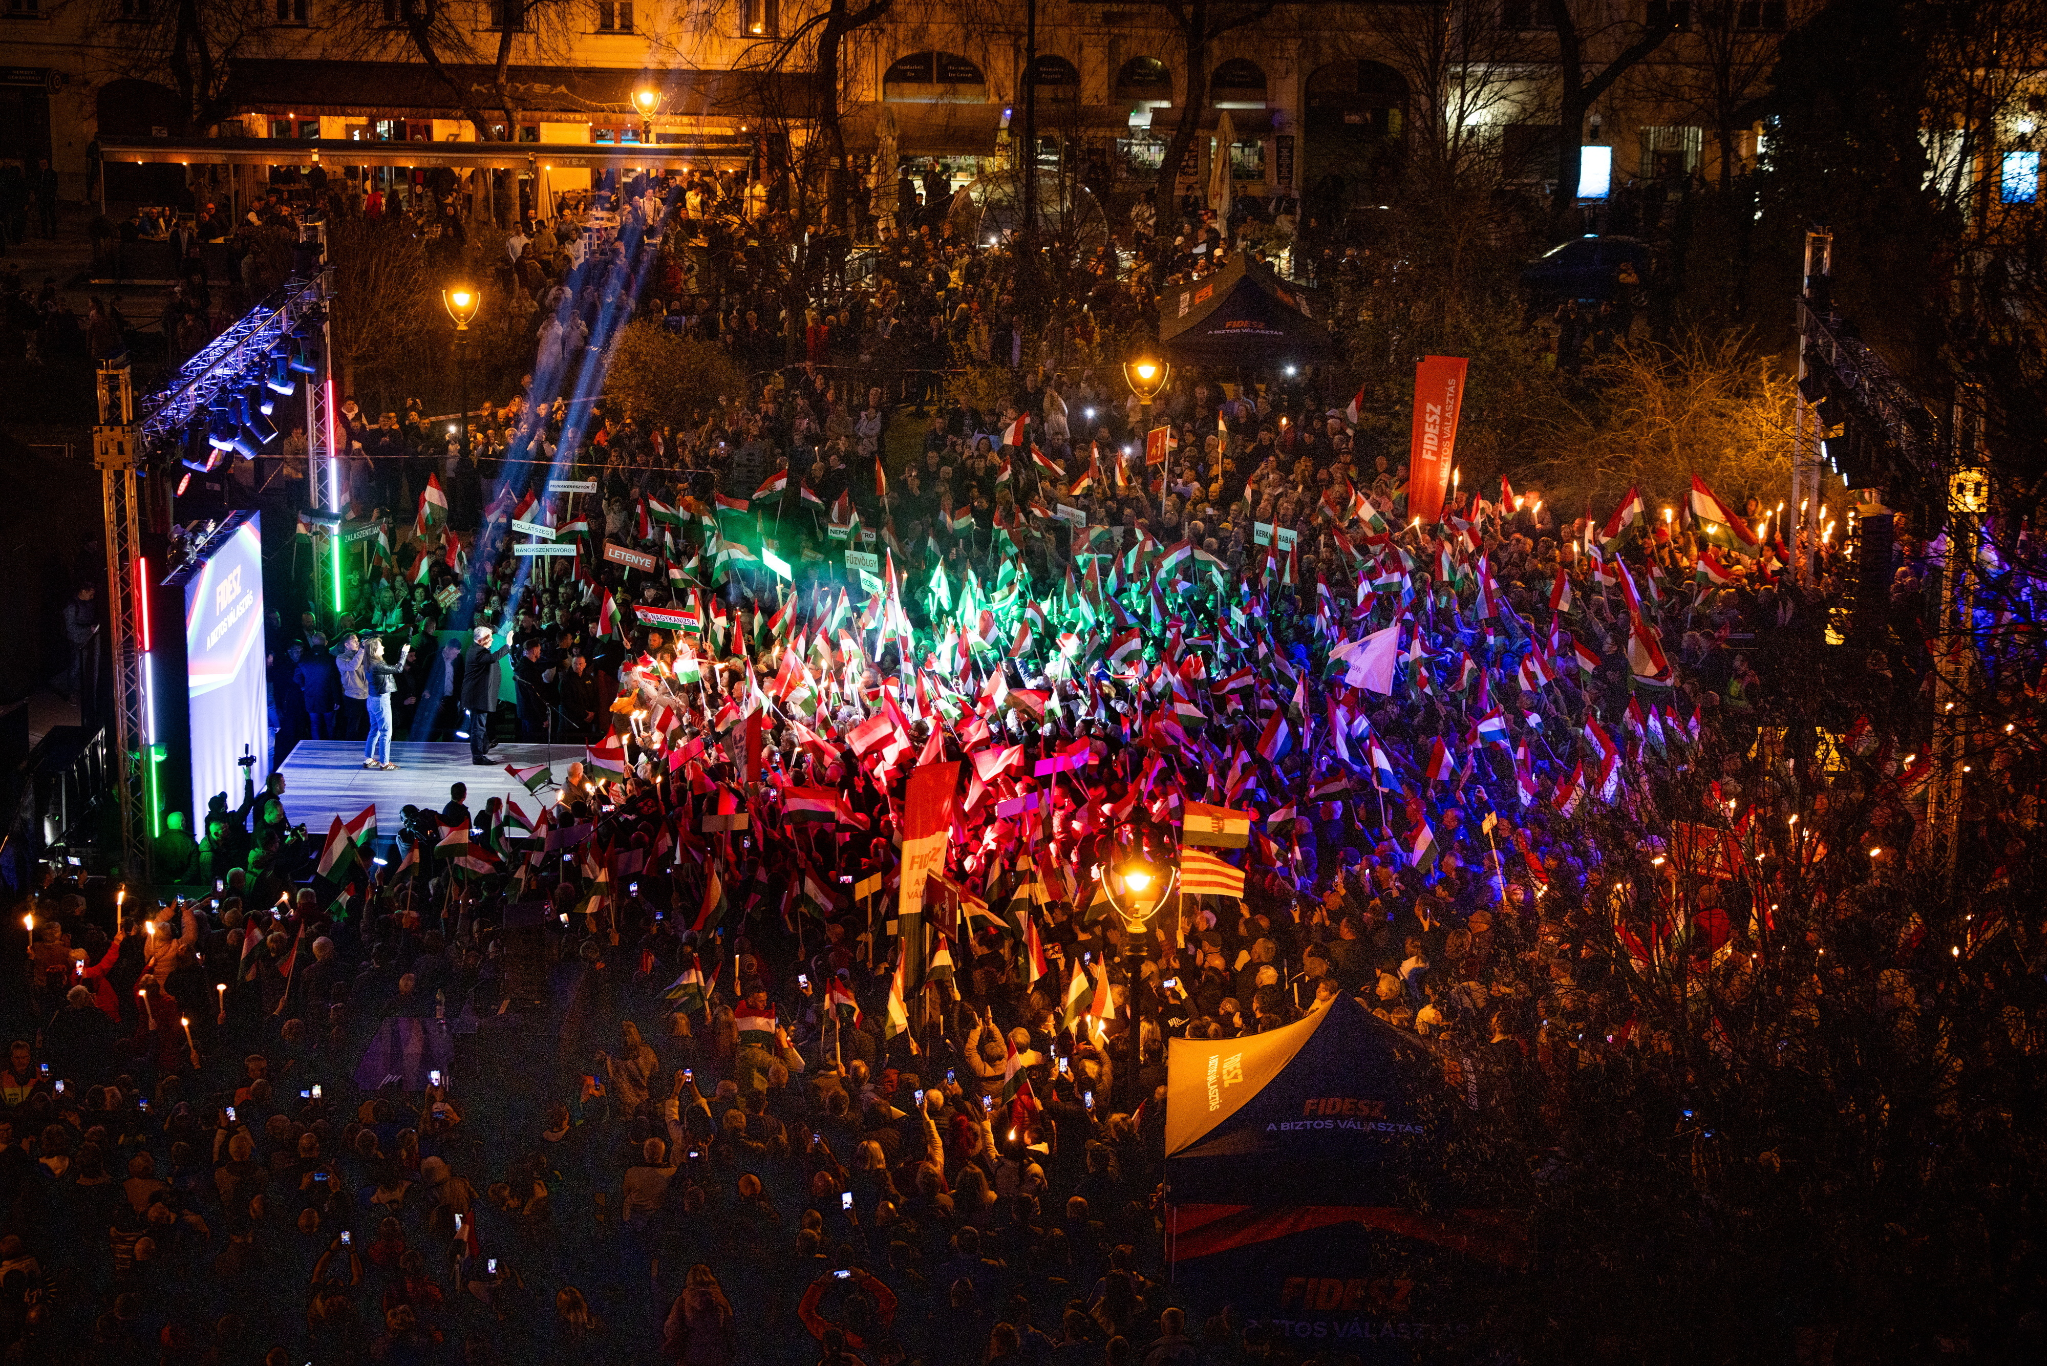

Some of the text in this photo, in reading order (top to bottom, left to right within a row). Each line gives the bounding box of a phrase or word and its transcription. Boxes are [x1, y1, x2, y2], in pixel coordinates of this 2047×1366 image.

[1225, 321, 1265, 329] FIDESZ
[1422, 402, 1442, 462] FIDESZ
[1439, 378, 1456, 487] A BIZTOS VÁLASZTÁS
[608, 548, 652, 568] LETENYE
[216, 564, 242, 617] FIDESZ
[210, 617, 228, 647] BIZTOS
[227, 589, 254, 630] VÁLASZTÁS
[650, 613, 697, 627] NAGYKANIZSA
[1222, 1052, 1244, 1088] FIDESZ
[1303, 1097, 1386, 1117] FIDESZ
[1266, 1117, 1425, 1134] A BIZTOS VÁLASZTÁS
[1281, 1275, 1415, 1311] FIDESZ
